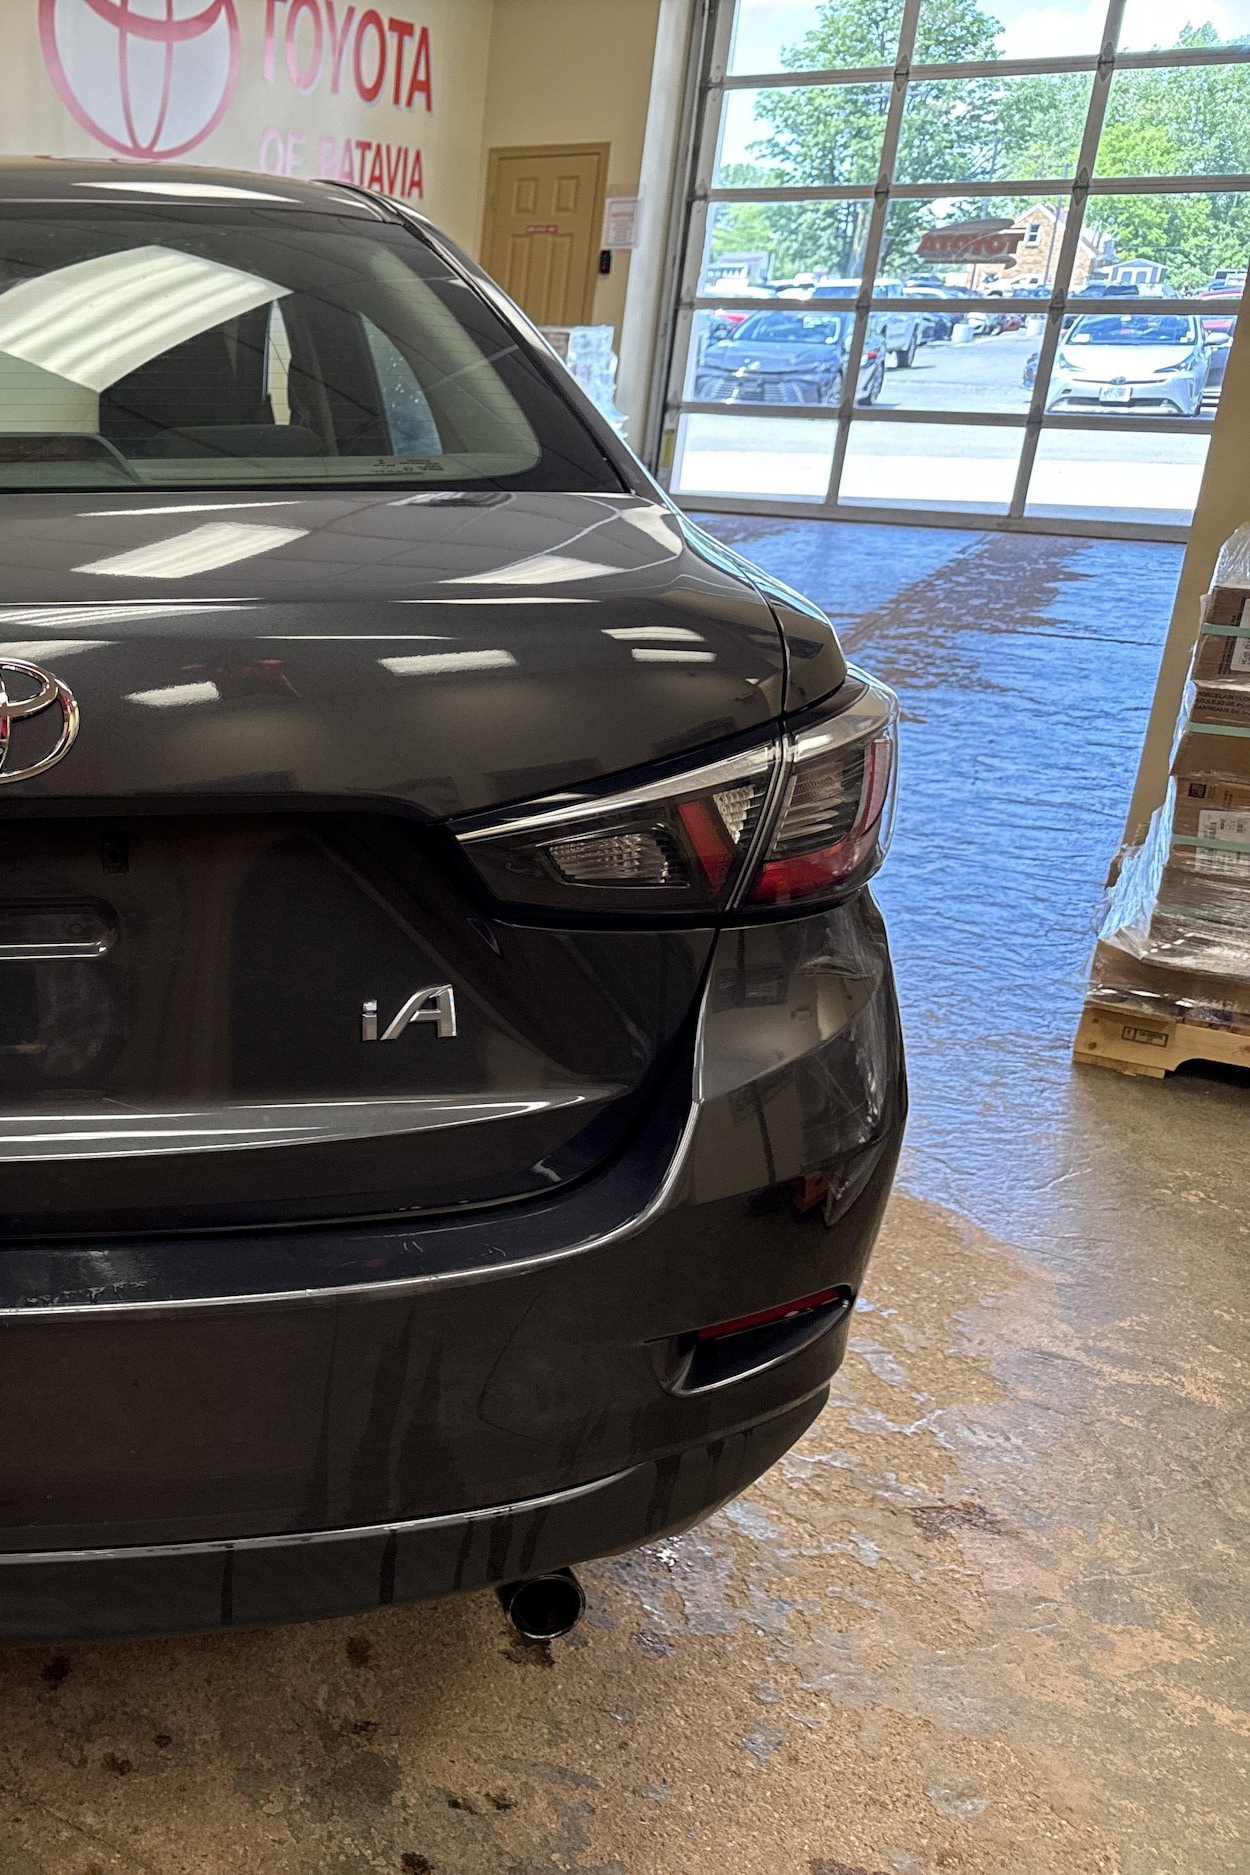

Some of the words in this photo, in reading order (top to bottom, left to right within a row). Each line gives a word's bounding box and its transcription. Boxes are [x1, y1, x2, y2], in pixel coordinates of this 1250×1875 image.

[263, 0, 433, 113] TOYOTA
[260, 125, 304, 177] OF
[317, 133, 424, 200] BATAVIA
[362, 984, 457, 1041] iA
